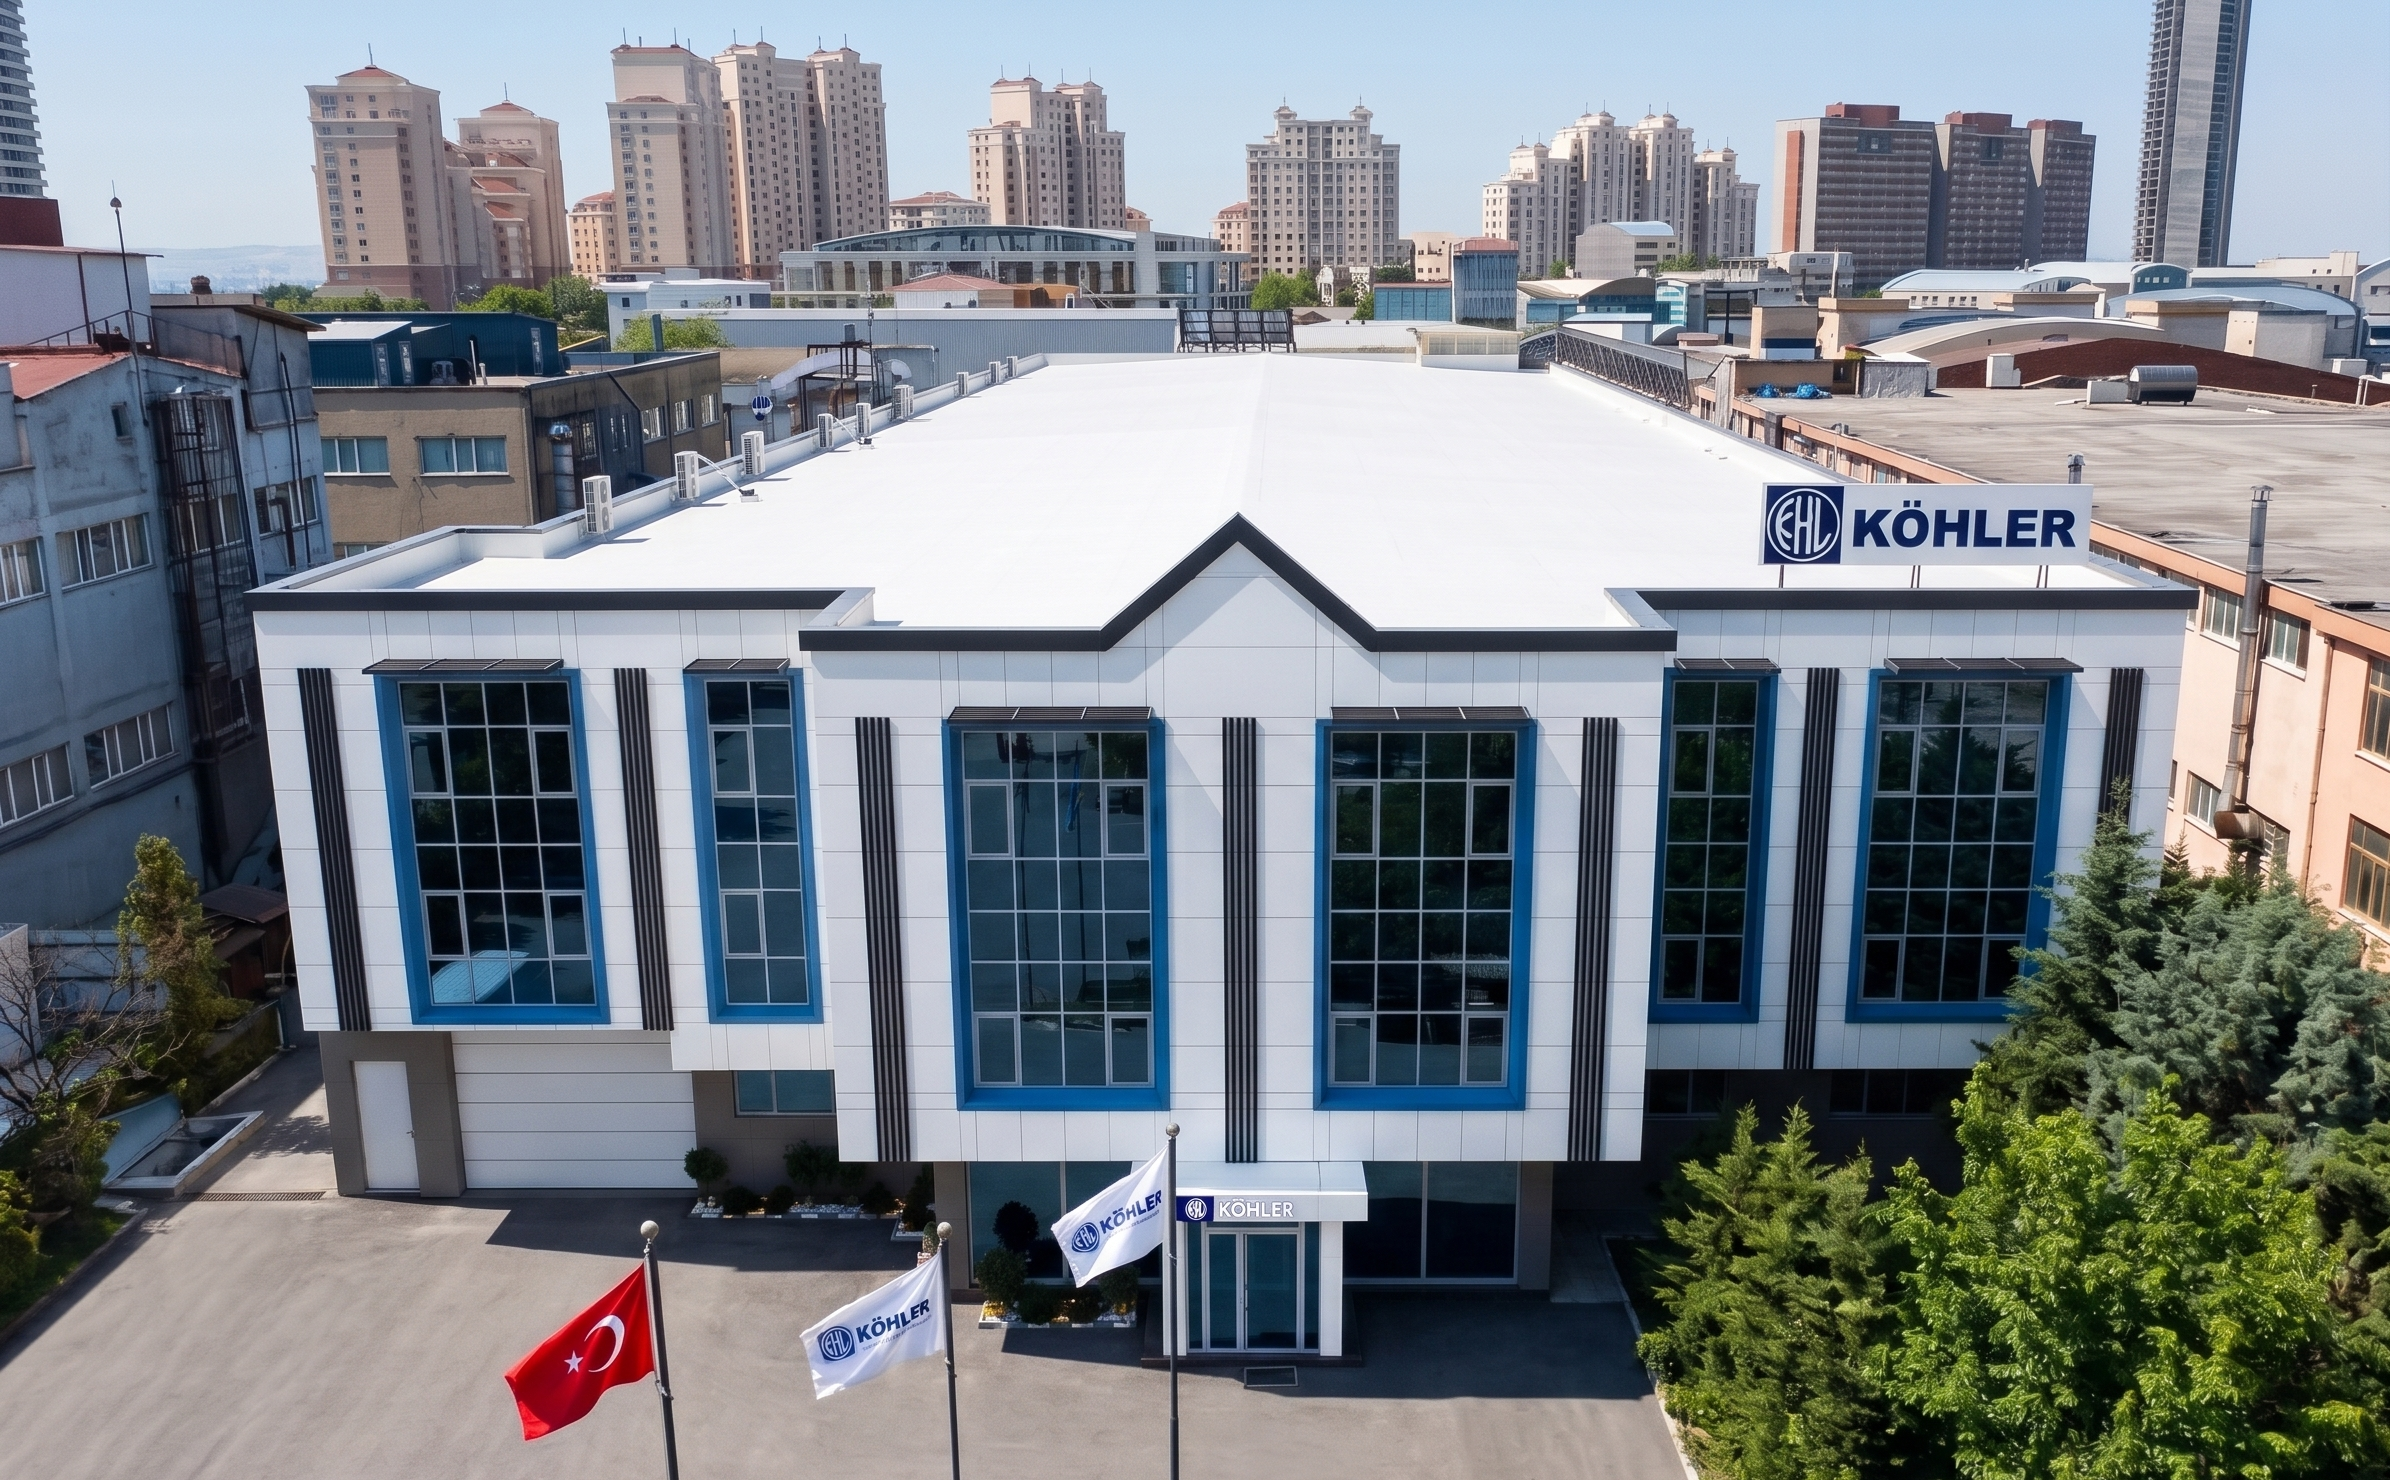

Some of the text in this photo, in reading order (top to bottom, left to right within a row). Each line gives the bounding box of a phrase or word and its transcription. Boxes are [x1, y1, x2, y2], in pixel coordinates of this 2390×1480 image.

[1773, 494, 2076, 556] EHL KÖHLER
[1100, 1190, 1162, 1234] KÖHLER
[1219, 1198, 1294, 1218] KÖHLER
[823, 1331, 850, 1357] EHL
[856, 1299, 930, 1343] KÖHLER
